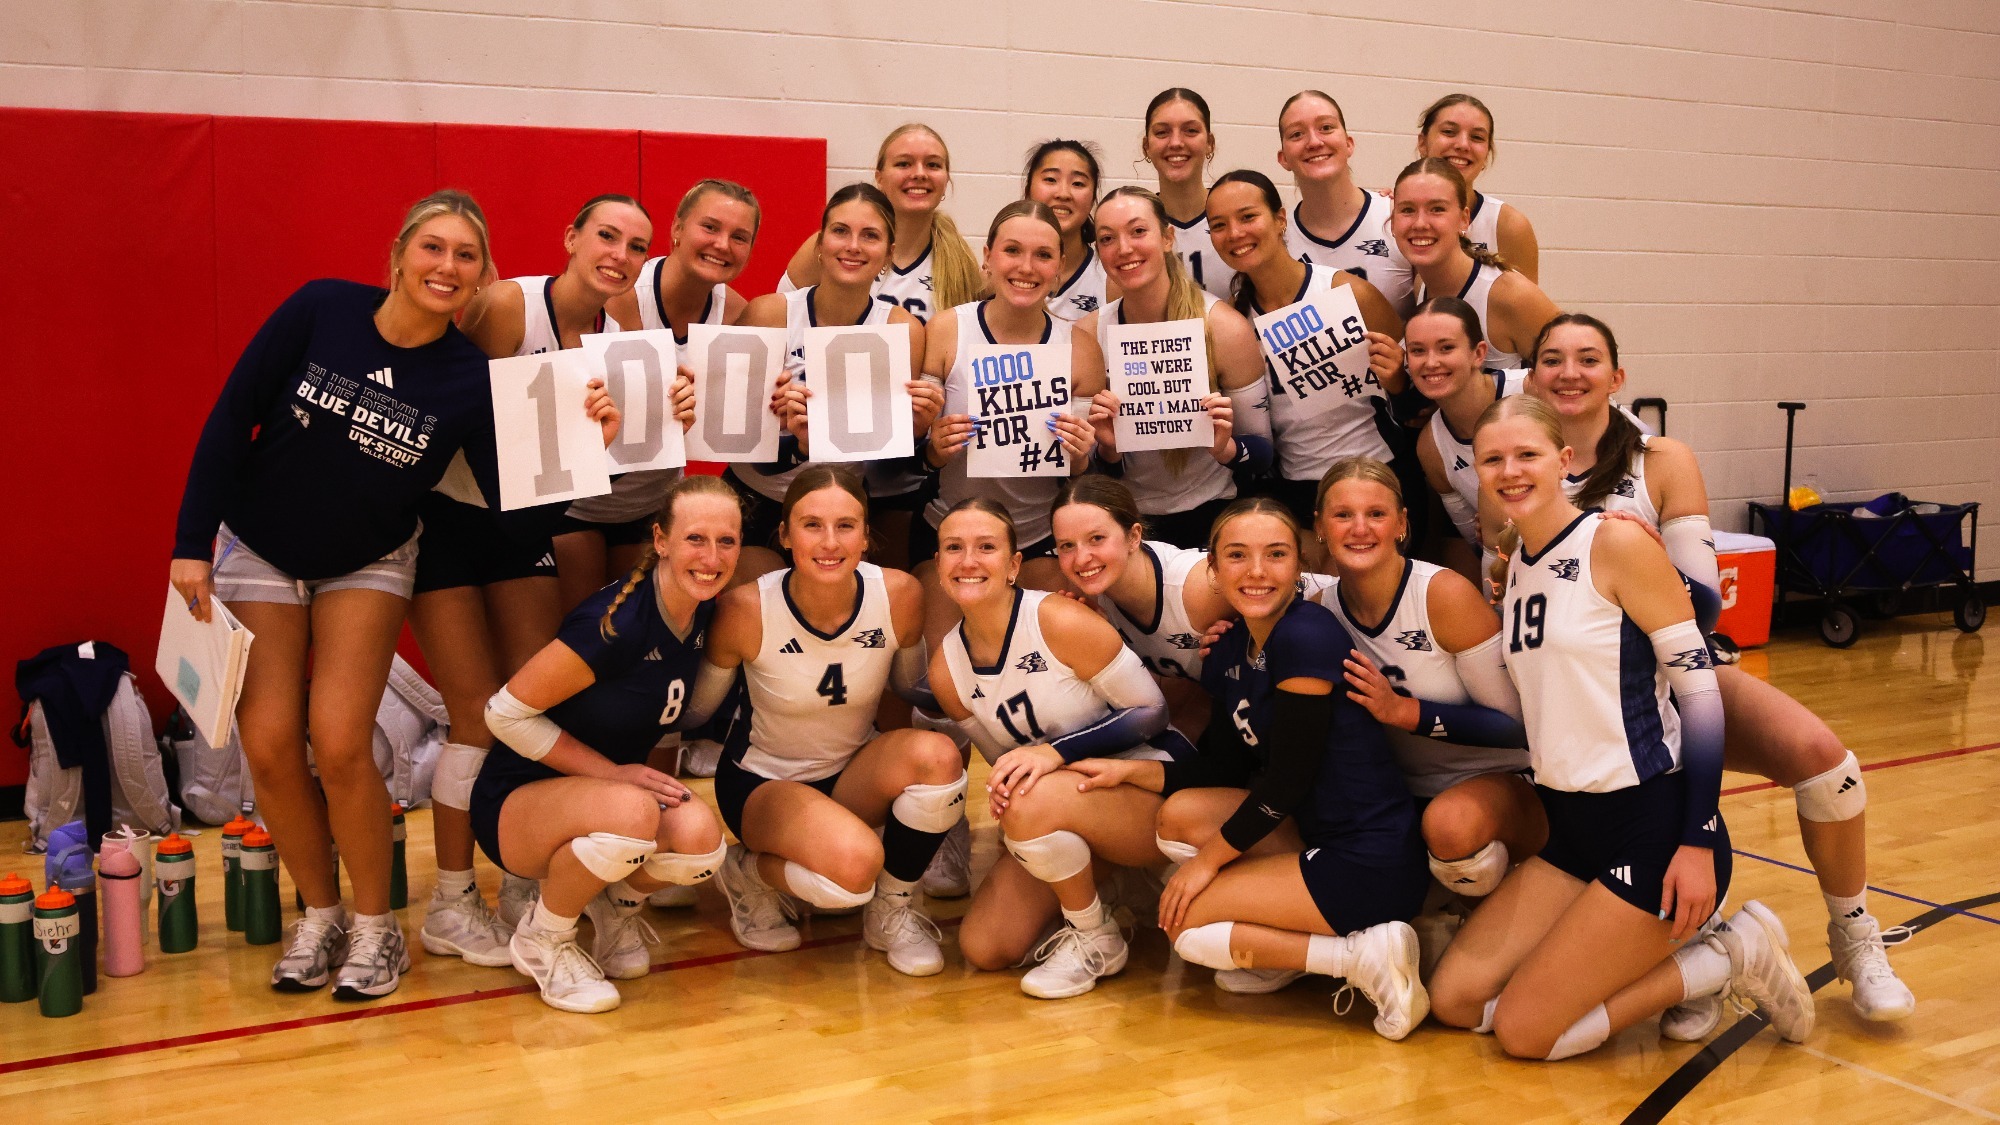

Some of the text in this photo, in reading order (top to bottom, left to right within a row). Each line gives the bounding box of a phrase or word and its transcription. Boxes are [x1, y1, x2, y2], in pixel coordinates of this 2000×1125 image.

[1120, 336, 1192, 355] THE FIRST
[1263, 304, 1324, 355] 1000
[1278, 315, 1366, 376] KILLS
[971, 351, 1034, 388] 1000
[1124, 358, 1192, 376] 999 WERE
[1287, 361, 1346, 399] FOR
[1341, 367, 1382, 398] #4
[977, 376, 1069, 417] KILLS
[1128, 379, 1191, 396] COOL BUT
[296, 380, 430, 450] BLUE DEVILS
[526, 332, 894, 497] 1 0 0 0
[1119, 401, 1154, 416] THAT
[1158, 401, 1165, 414] 1
[1134, 419, 1193, 435] HISTORY
[348, 429, 421, 466] UW-STOUT
[973, 415, 1031, 450] FOR
[359, 445, 404, 469] VOLLEYBALL
[1019, 440, 1065, 472] #4
[1509, 592, 1548, 654] 19
[658, 678, 685, 726] 8
[816, 662, 848, 706] 4
[995, 688, 1048, 746] 17
[1232, 698, 1259, 747] 5
[34, 920, 73, 938] Siehr
